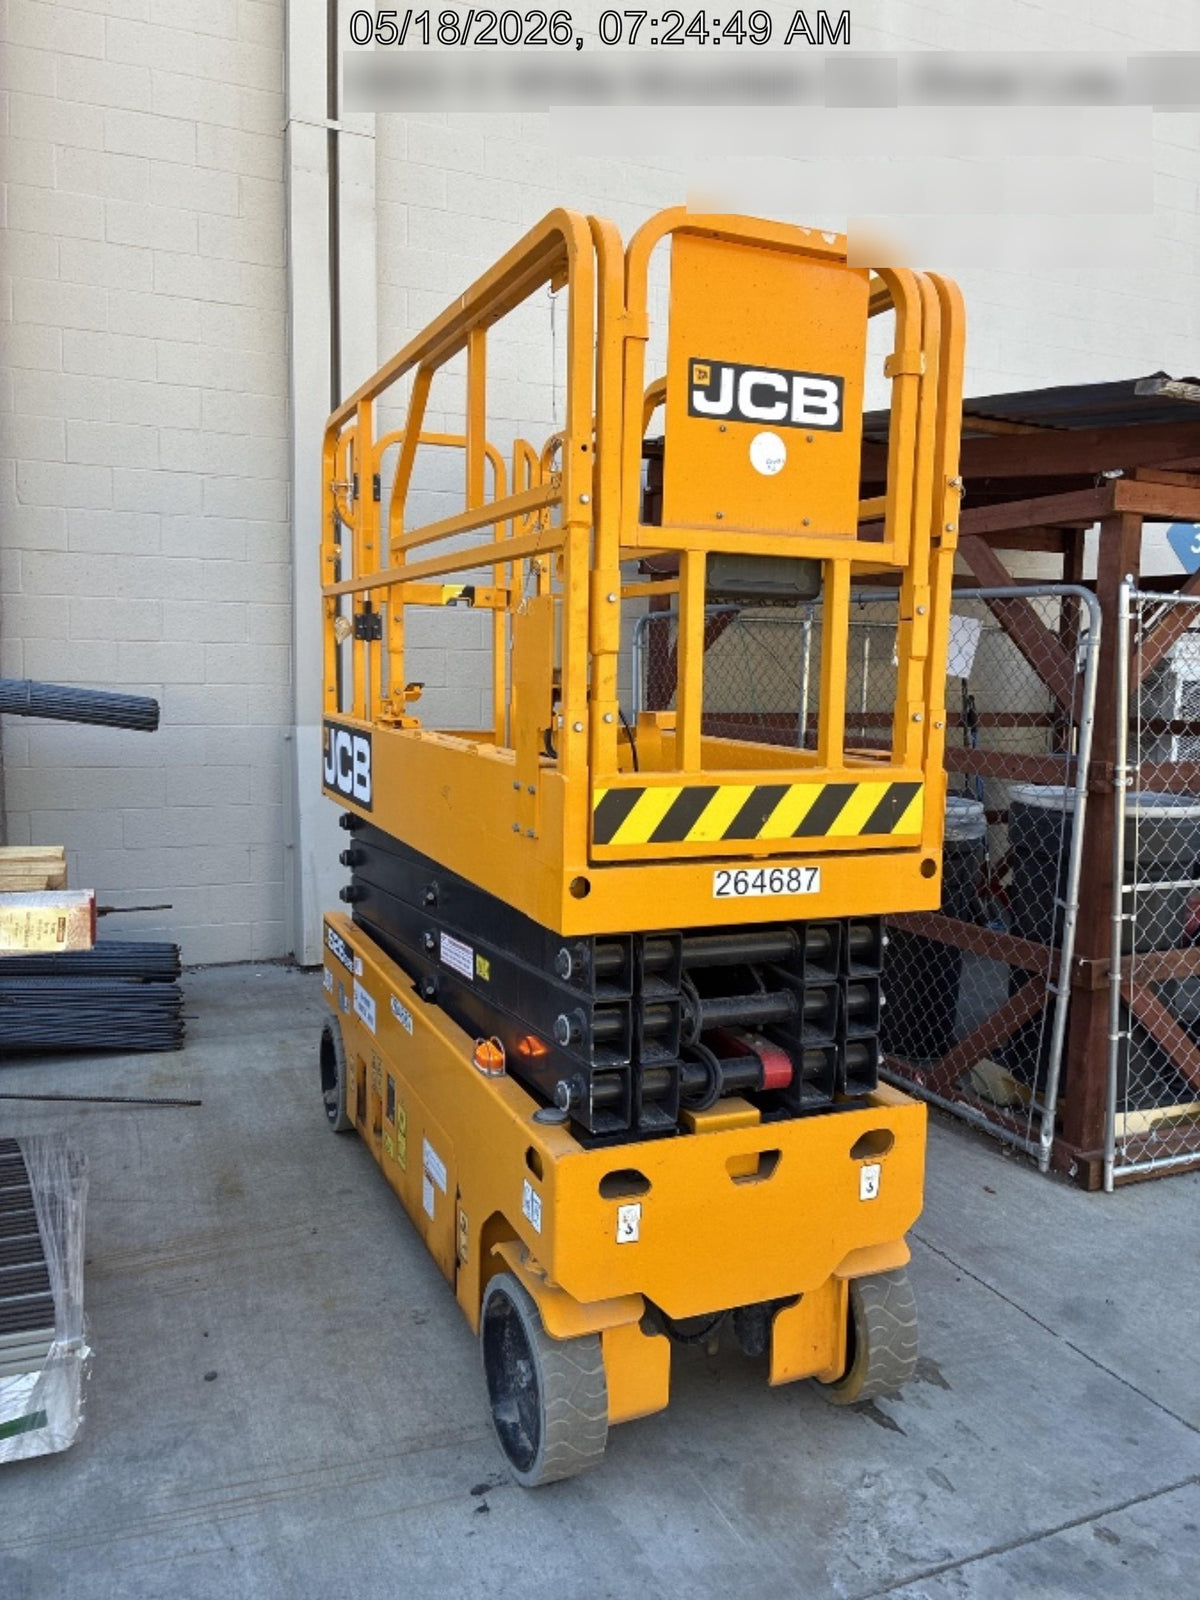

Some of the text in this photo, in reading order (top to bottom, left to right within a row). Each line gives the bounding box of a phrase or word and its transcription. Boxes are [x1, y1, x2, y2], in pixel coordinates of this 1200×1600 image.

[692, 367, 840, 426] JCB
[324, 728, 371, 803] JCB
[716, 867, 819, 896] 264687
